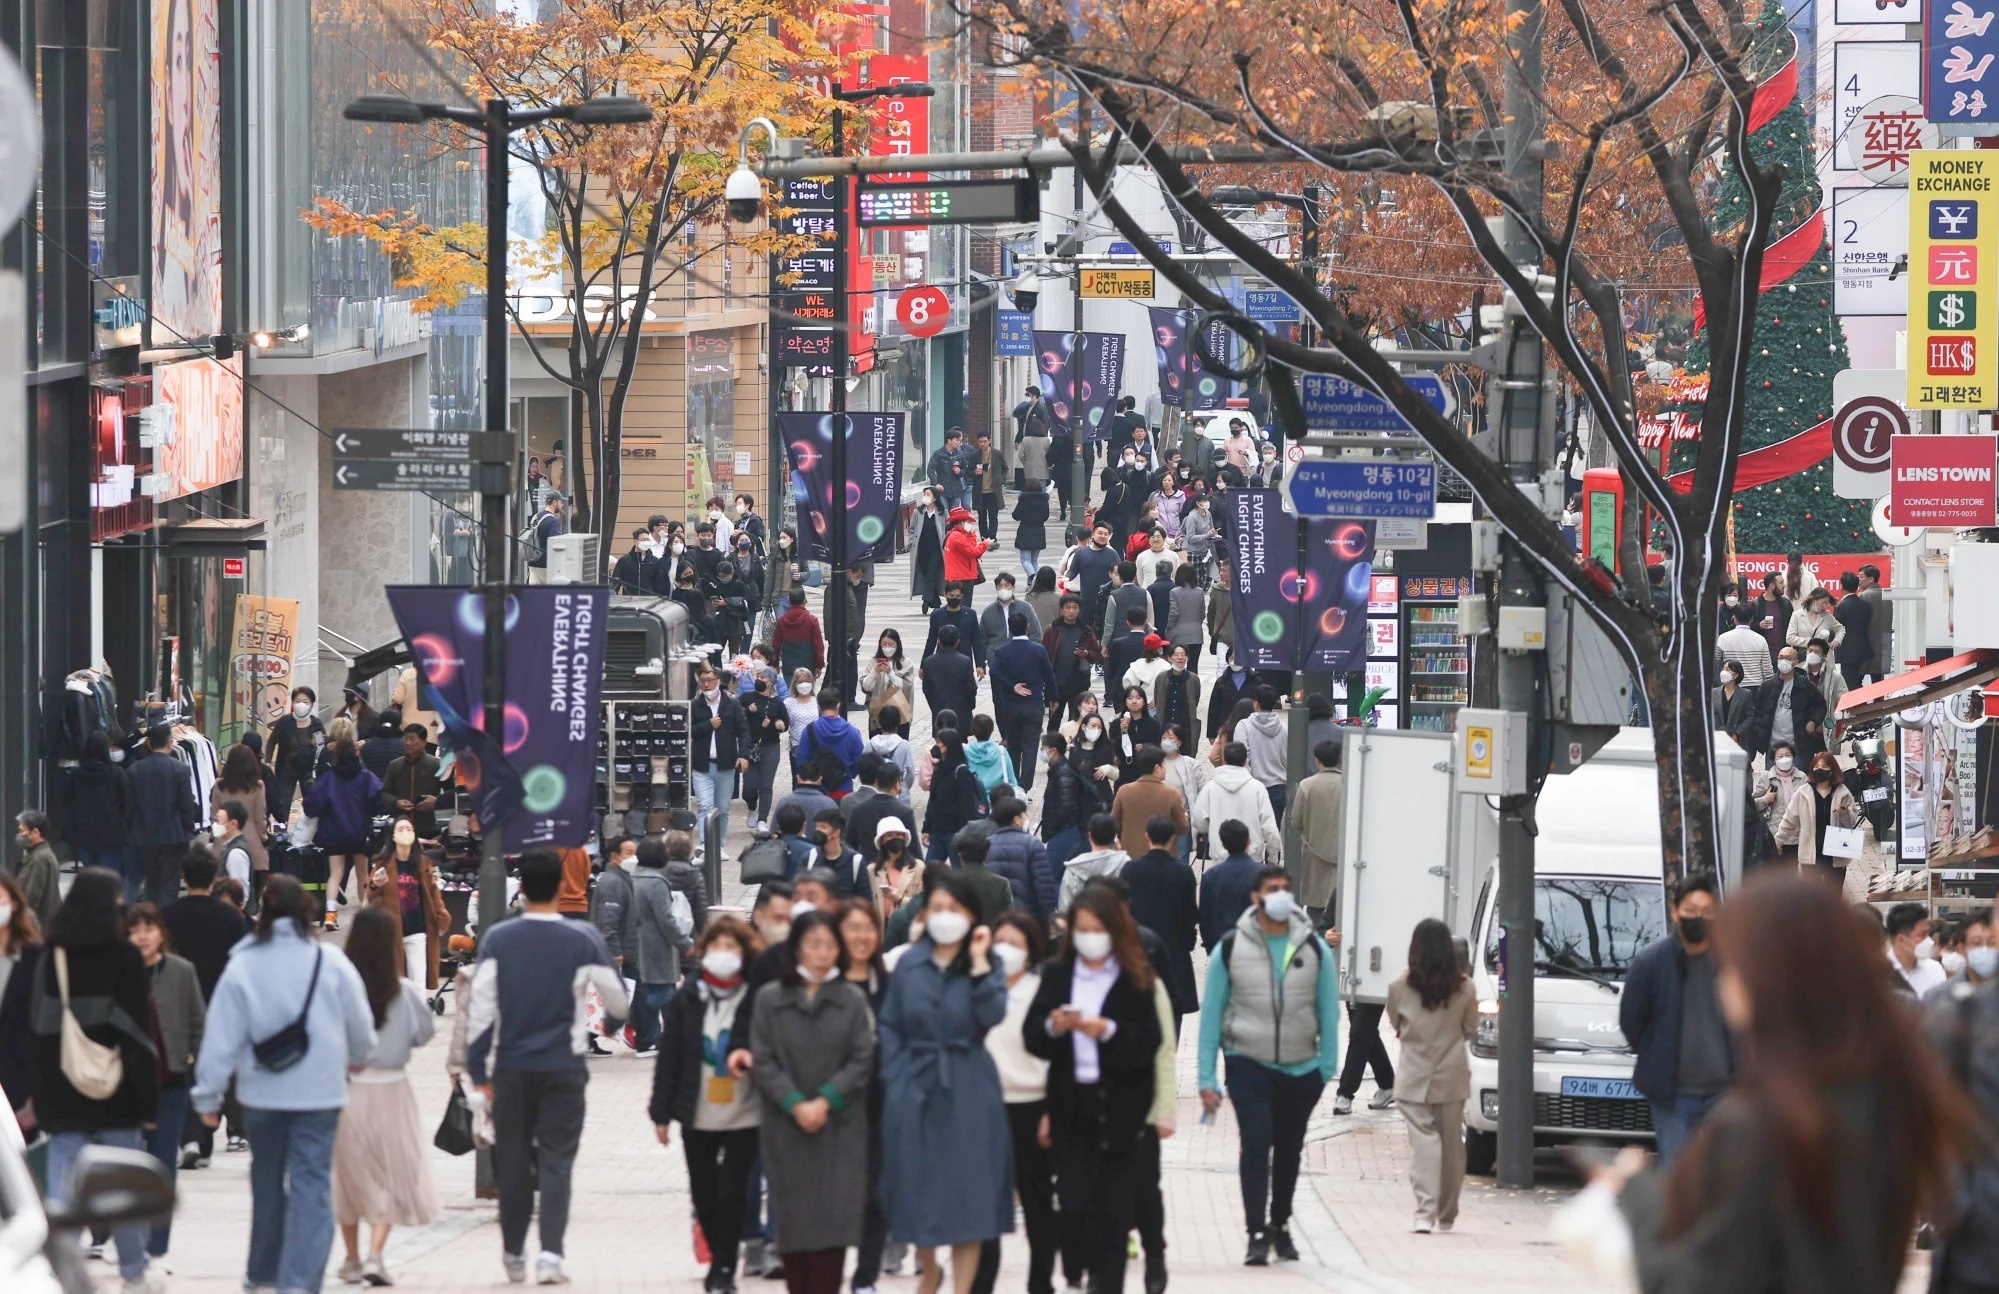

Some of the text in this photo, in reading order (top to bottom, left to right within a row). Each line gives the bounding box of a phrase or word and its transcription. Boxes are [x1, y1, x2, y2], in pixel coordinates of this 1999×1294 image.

[1844, 73, 1861, 97] 4
[1862, 111, 1923, 172] 藥
[1929, 161, 1984, 174] MONEY
[790, 182, 819, 190] Coffee
[1917, 178, 1991, 191] EXCHANGE
[1935, 206, 1971, 233] ¥
[1843, 220, 1858, 244] 2
[1843, 252, 1888, 263] 신한은행
[1935, 250, 1971, 280] 元
[872, 261, 897, 274] 동산
[1096, 272, 1117, 280] 다목적
[1096, 280, 1151, 296] CCTV작동중
[1843, 280, 1872, 289] 명동지점
[1249, 305, 1286, 313] Myeongdong
[1938, 293, 1965, 328] $
[1930, 340, 1975, 372] HK$
[1426, 388, 1437, 397] 52
[1920, 386, 1982, 404] 고래환전
[1306, 402, 1383, 415] Myeongdong
[1363, 466, 1432, 486] 명동10길
[1897, 467, 1991, 482] LENS TOWN
[1315, 487, 1431, 502] Myeongdong 10-gil
[1903, 498, 1984, 506] CONTACT LENS STORE
[1253, 494, 1265, 574] EVERYTHING
[1238, 494, 1251, 594] LIGHT CHANGES
[1376, 623, 1394, 644] 권
[1570, 1080, 1599, 1095] 94버
